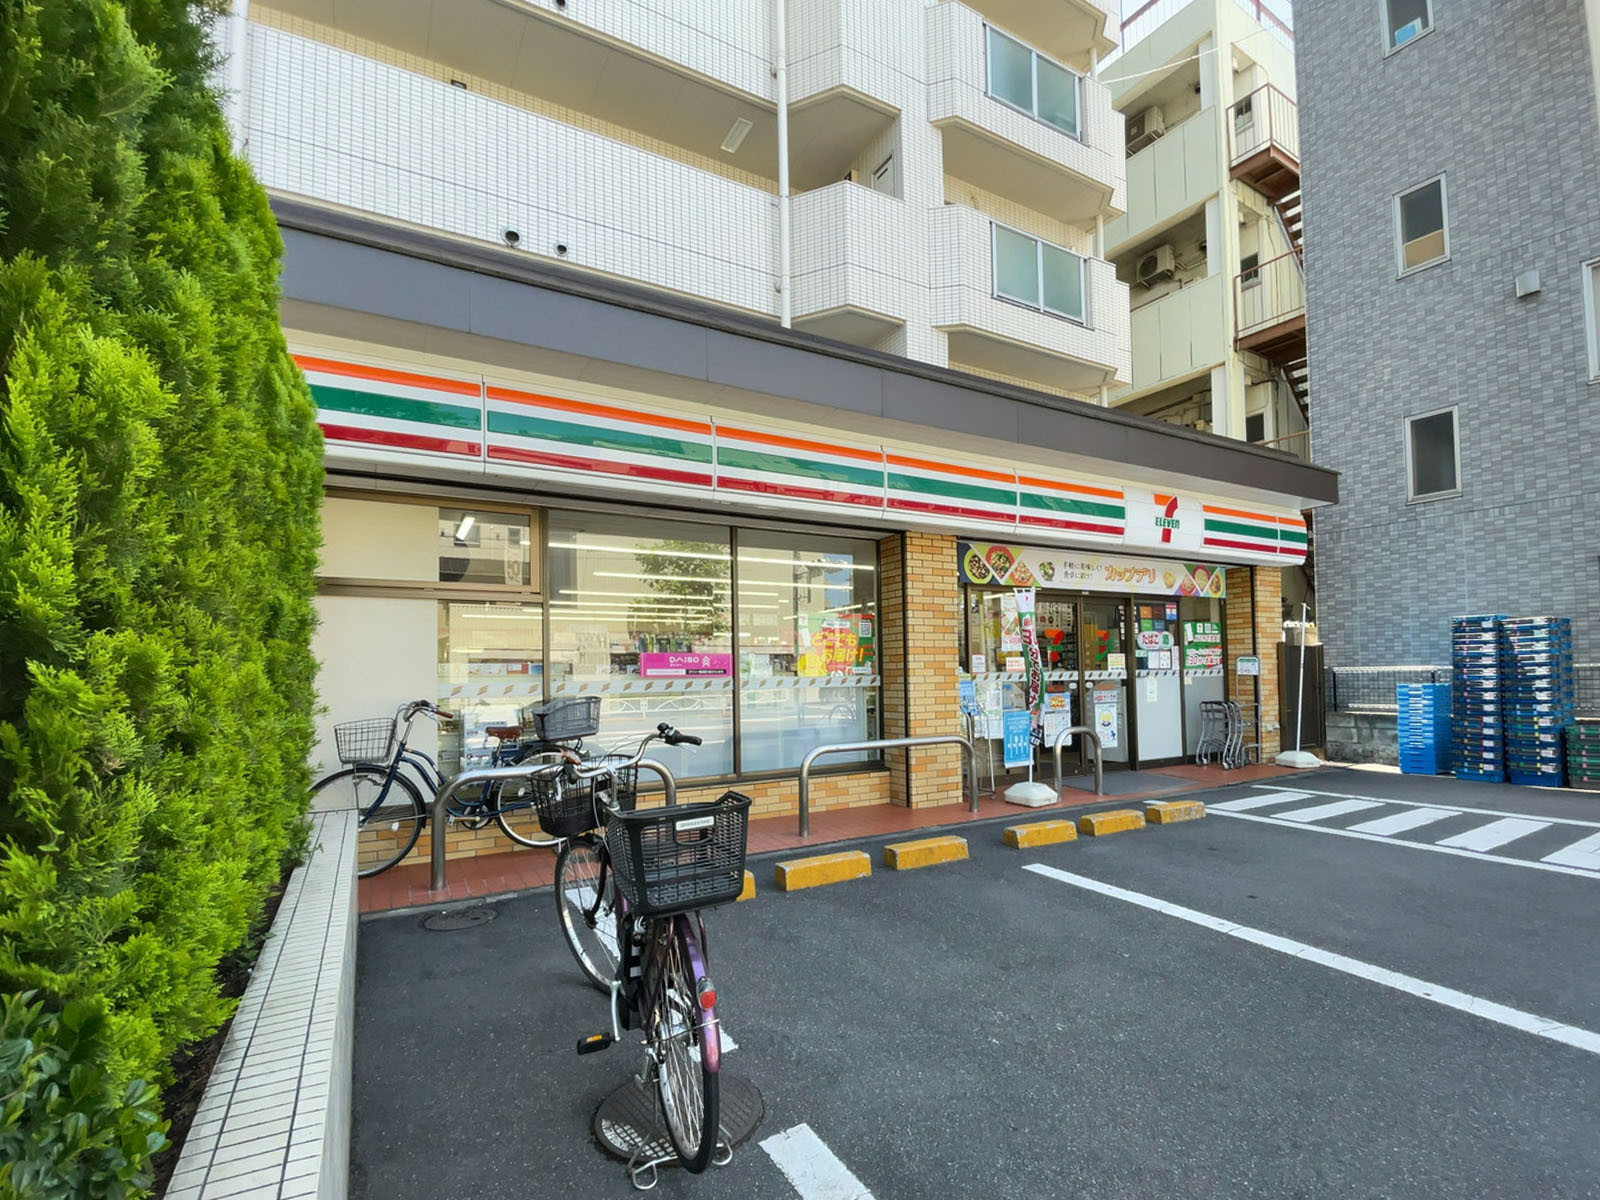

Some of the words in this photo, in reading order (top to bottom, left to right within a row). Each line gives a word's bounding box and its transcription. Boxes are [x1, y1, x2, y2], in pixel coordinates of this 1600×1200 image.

[1154, 493, 1178, 543] 7
[1104, 565, 1156, 584] カップデリ
[811, 632, 857, 648] どこでも
[1142, 634, 1159, 645] たばこ
[669, 656, 699, 664] DAISO
